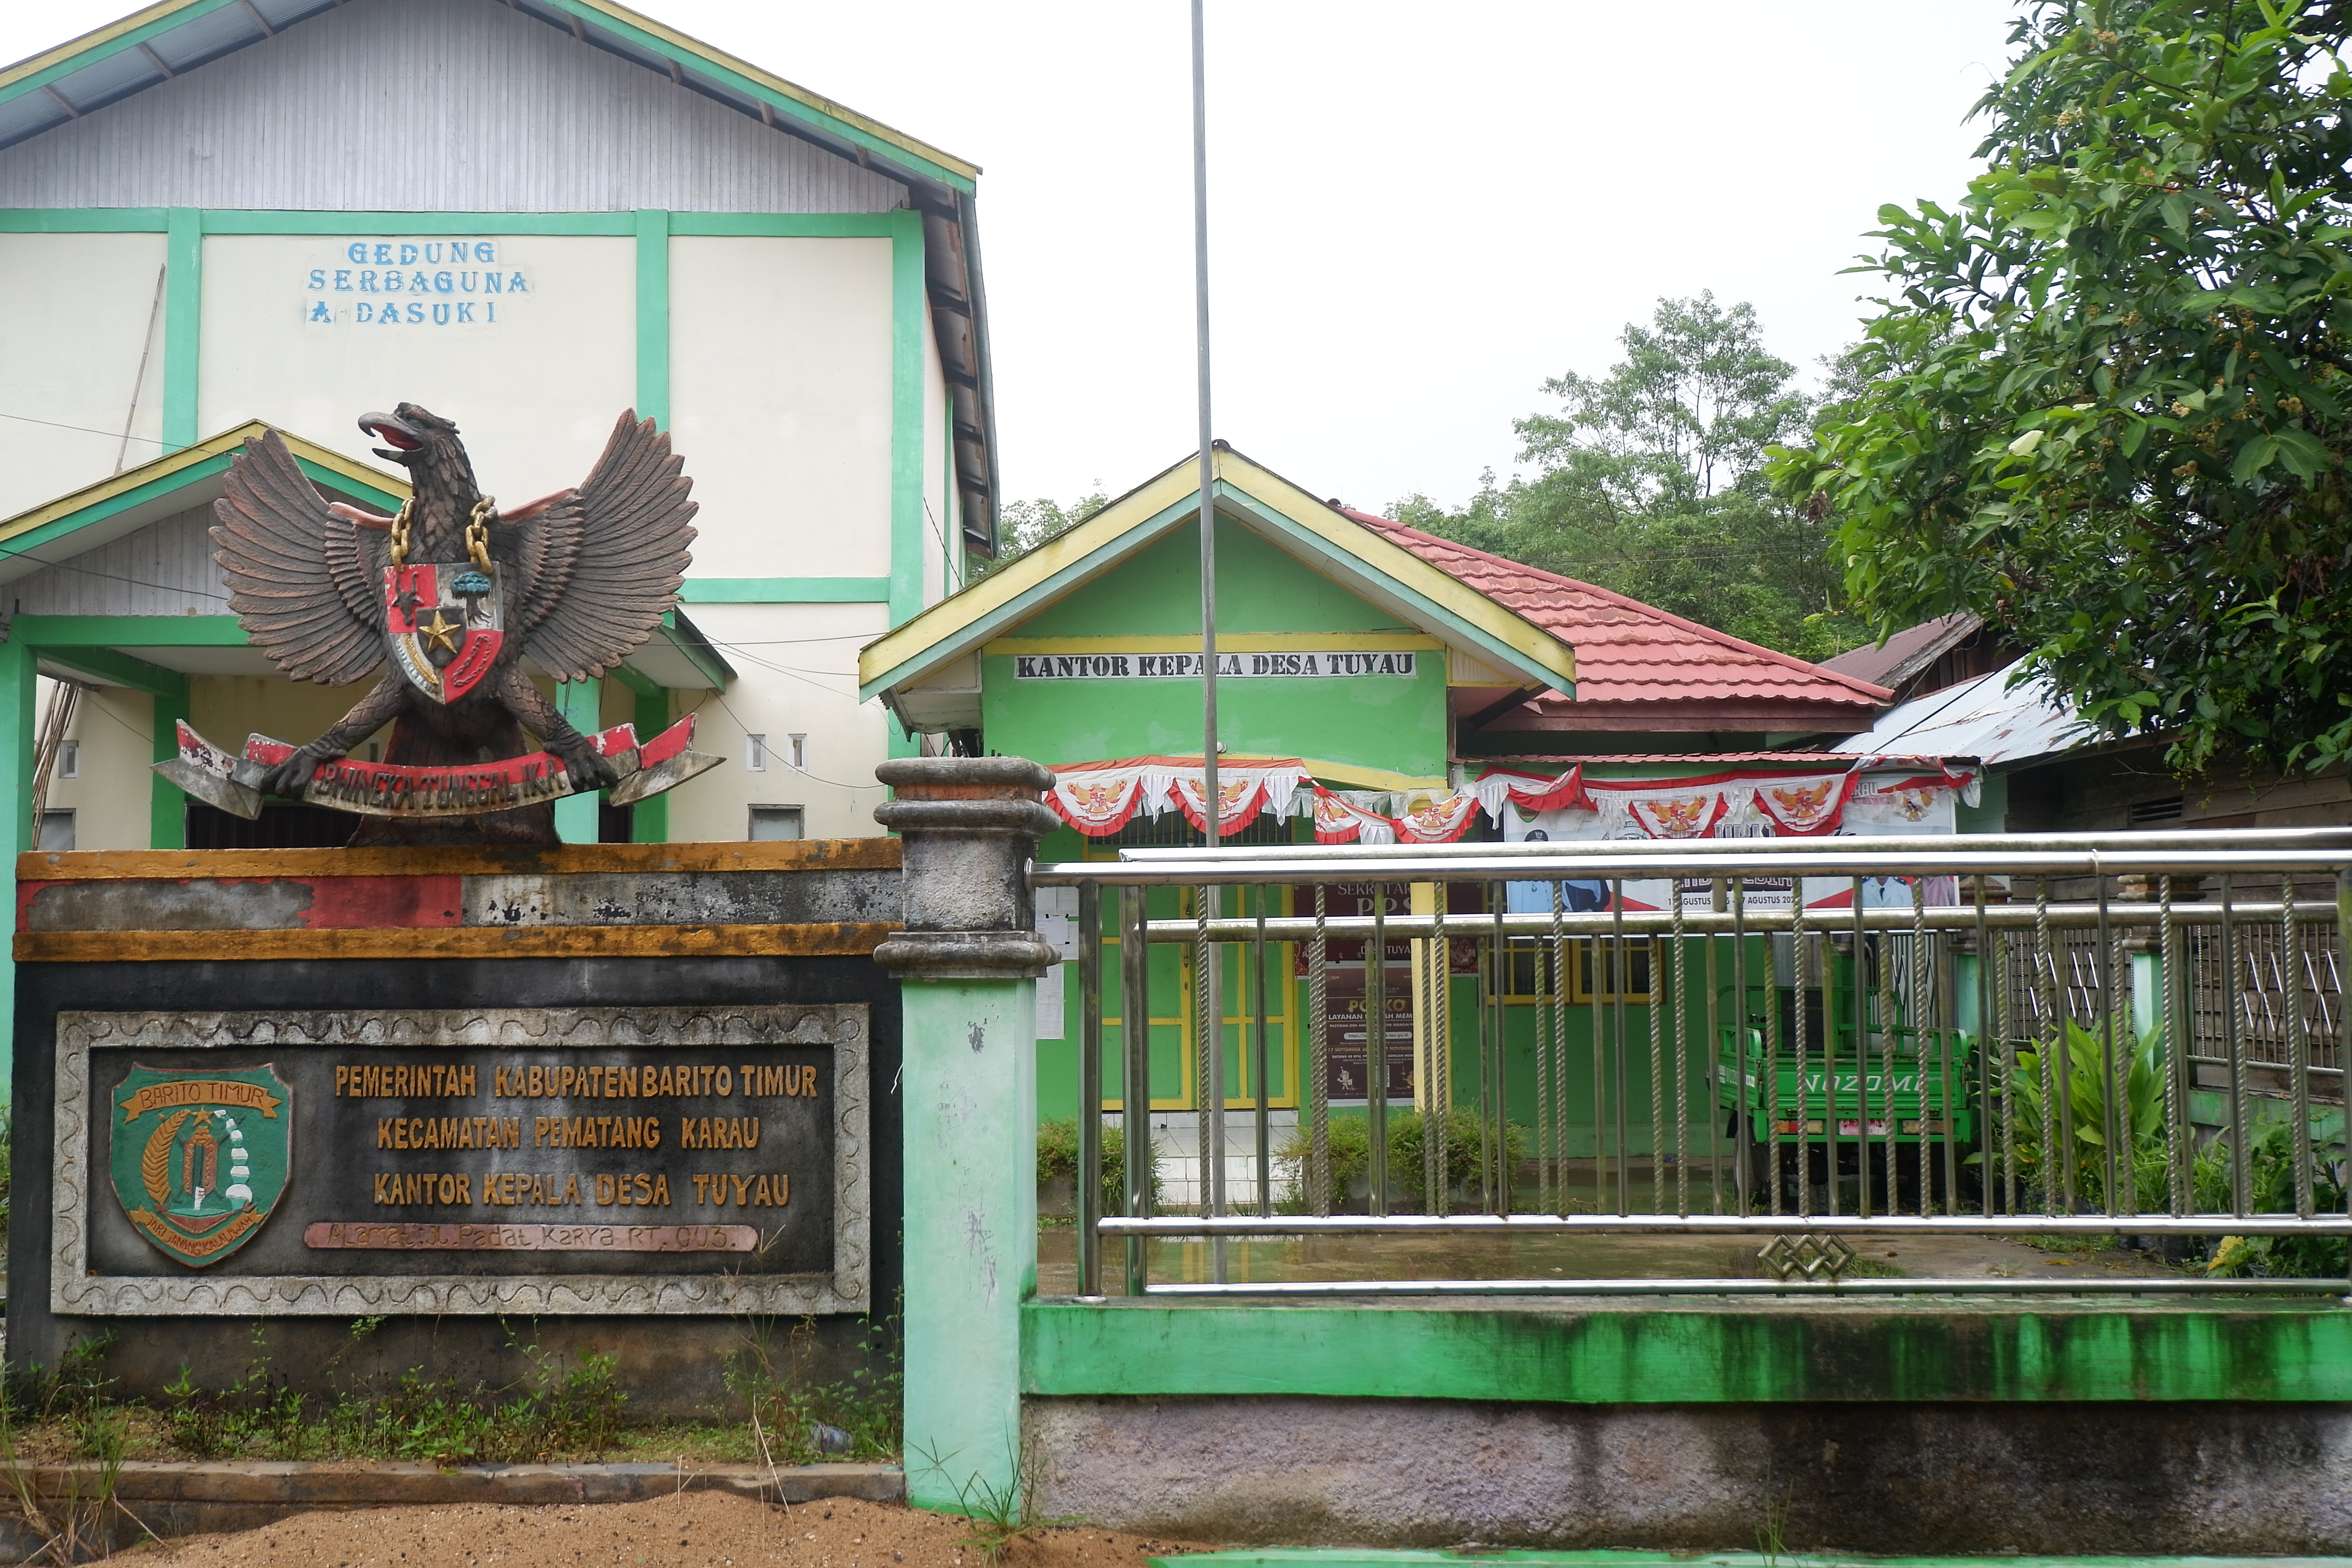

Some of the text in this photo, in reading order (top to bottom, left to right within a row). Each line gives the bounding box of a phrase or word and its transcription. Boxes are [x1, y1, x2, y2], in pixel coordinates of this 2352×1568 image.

[348, 242, 495, 265] GEDUNG
[308, 270, 529, 293] SERBAGUNA
[356, 302, 496, 325] DASUKI
[1017, 656, 1130, 677] KANTOR
[1252, 655, 1319, 675] DESA
[1327, 654, 1413, 674] TUYAU
[420, 770, 518, 810] TUNGGAL
[521, 758, 566, 797] IKA
[1681, 897, 1711, 906] GUSTUS
[1747, 896, 1780, 904] AGUSTUS
[1782, 895, 1794, 904] 202
[335, 1064, 818, 1098] PEMERINTAH KABUPATEN BARITO TIMUR
[139, 1083, 264, 1109] BARITO TIMUR
[378, 1116, 760, 1150] KECAMATAN PEMATANG KARAU
[374, 1173, 789, 1206] KANTOR KEPALA DESA TUYAU
[144, 1216, 168, 1237] JARI
[459, 1224, 531, 1247] Padat
